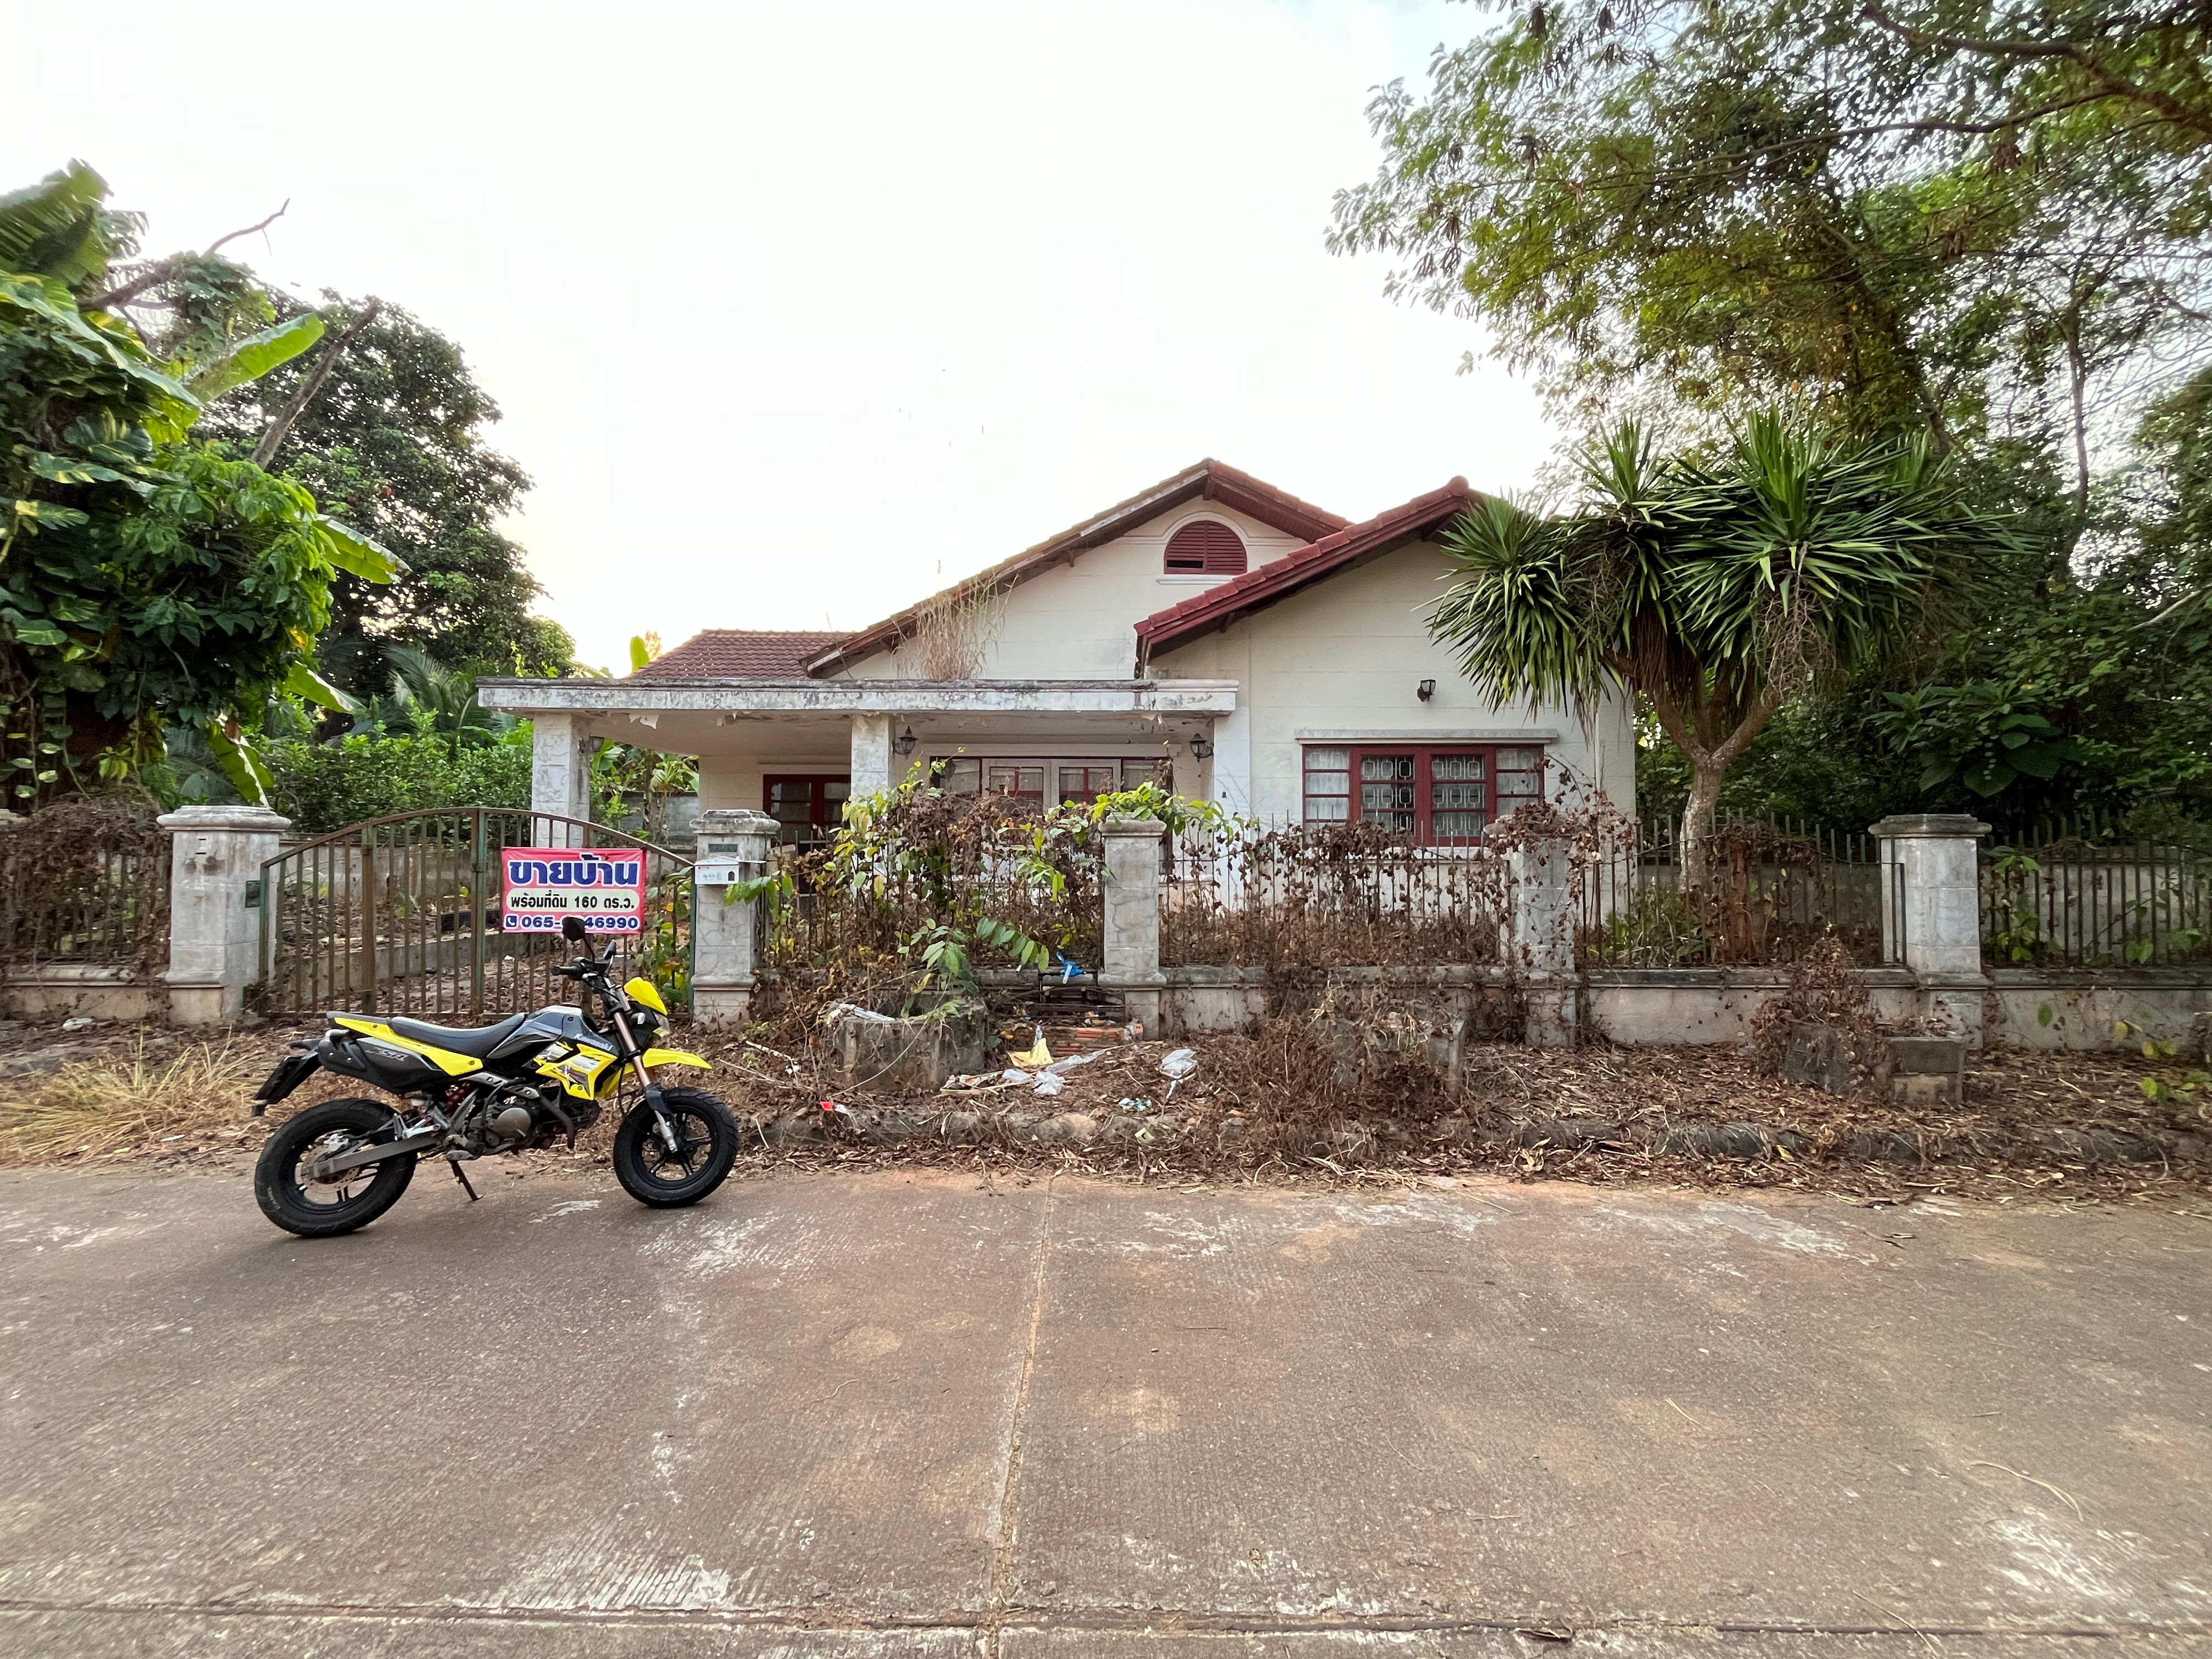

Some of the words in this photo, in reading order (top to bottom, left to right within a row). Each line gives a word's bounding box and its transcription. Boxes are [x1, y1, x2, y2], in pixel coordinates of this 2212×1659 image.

[509, 854, 638, 884] ขายบ้าน
[511, 890, 567, 908] พร้อมที่ดิน
[574, 896, 597, 909] 160
[603, 897, 635, 909] ตร.ว.
[522, 916, 638, 928] 065-46990
[574, 1033, 613, 1052] Kawasaki
